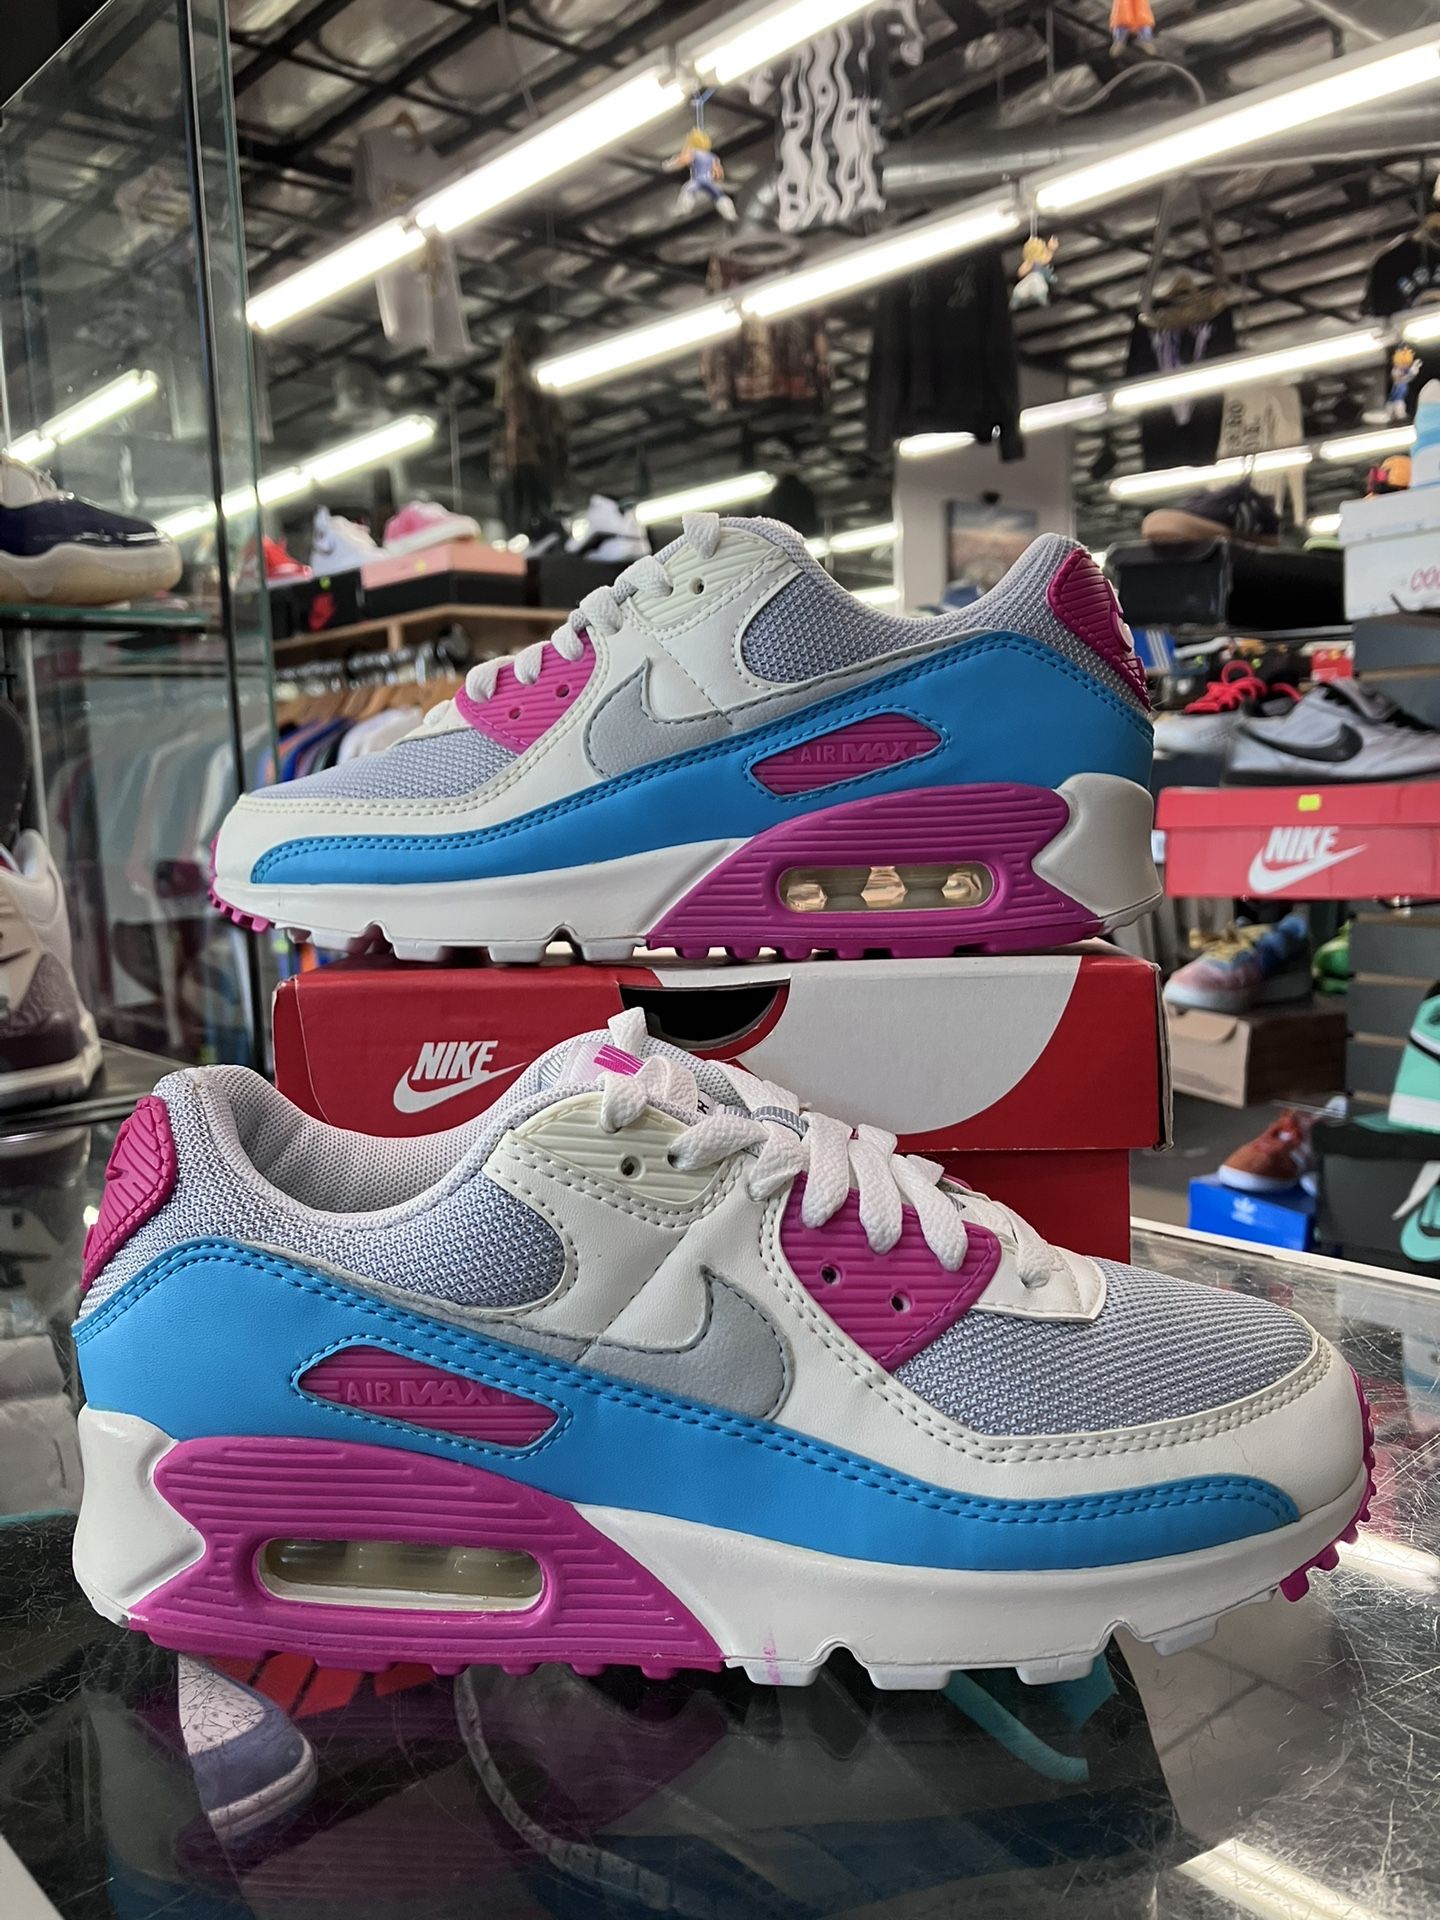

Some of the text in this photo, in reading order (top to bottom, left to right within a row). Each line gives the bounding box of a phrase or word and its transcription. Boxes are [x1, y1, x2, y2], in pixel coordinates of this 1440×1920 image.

[800, 741, 909, 763] AIR MAX
[1264, 826, 1339, 862] NIKE
[411, 1040, 499, 1081] NIKE
[346, 1380, 491, 1405] AIR MAX
